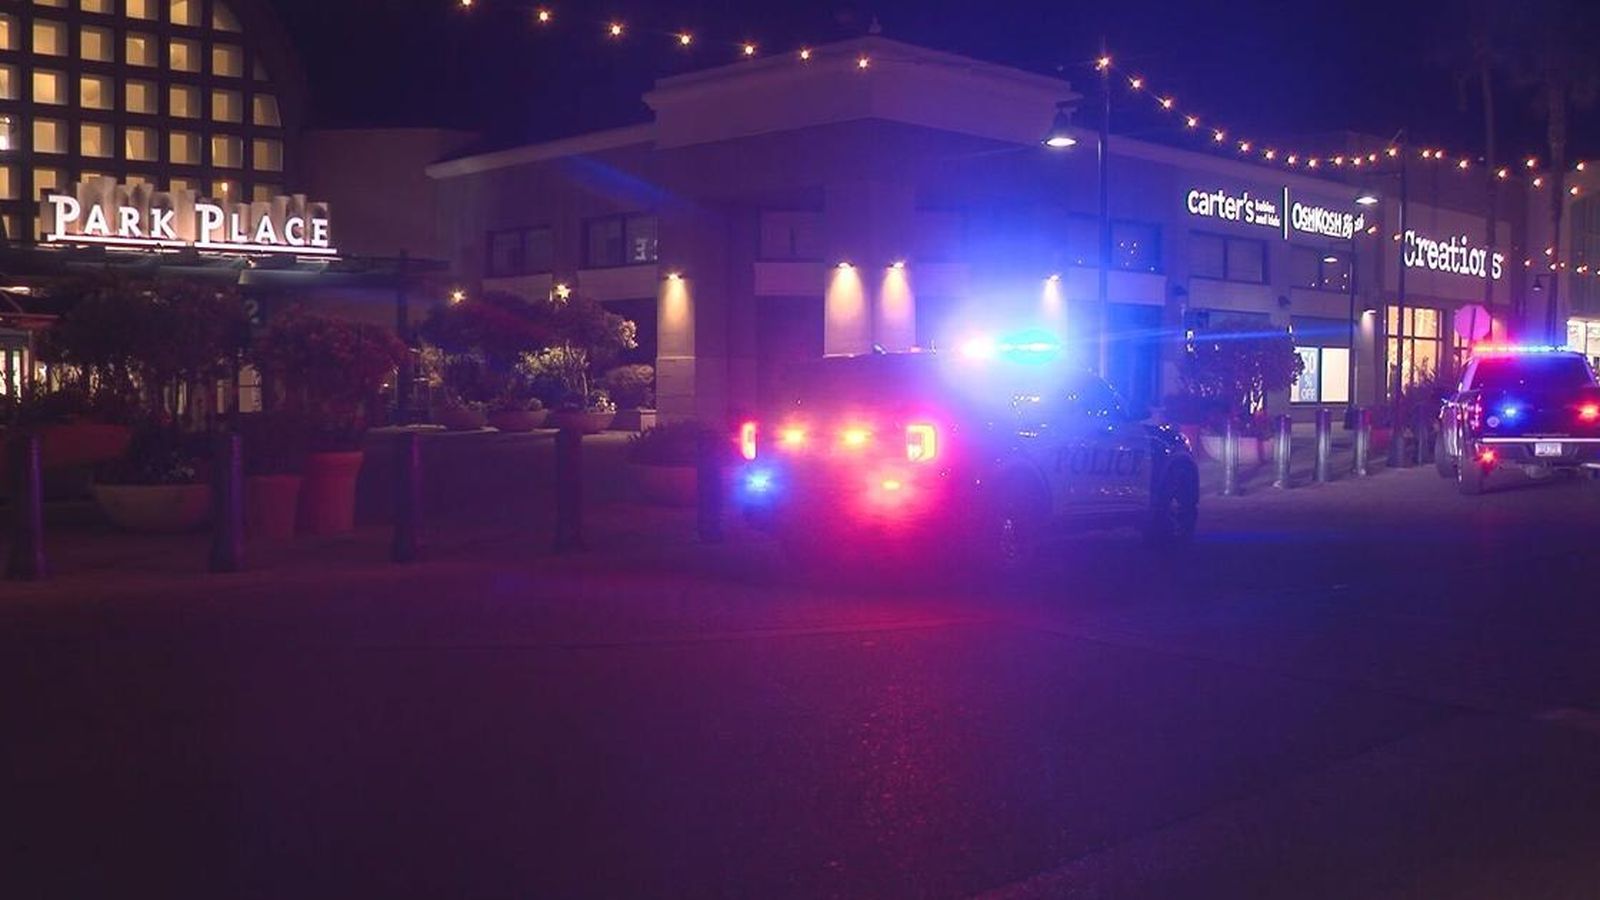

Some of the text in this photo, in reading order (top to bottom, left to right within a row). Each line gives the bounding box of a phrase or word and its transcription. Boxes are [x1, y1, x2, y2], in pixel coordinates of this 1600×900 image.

[49, 194, 329, 247] PARK PLACE
[1187, 189, 1255, 224] carter's
[1054, 448, 1145, 477] POLICE
